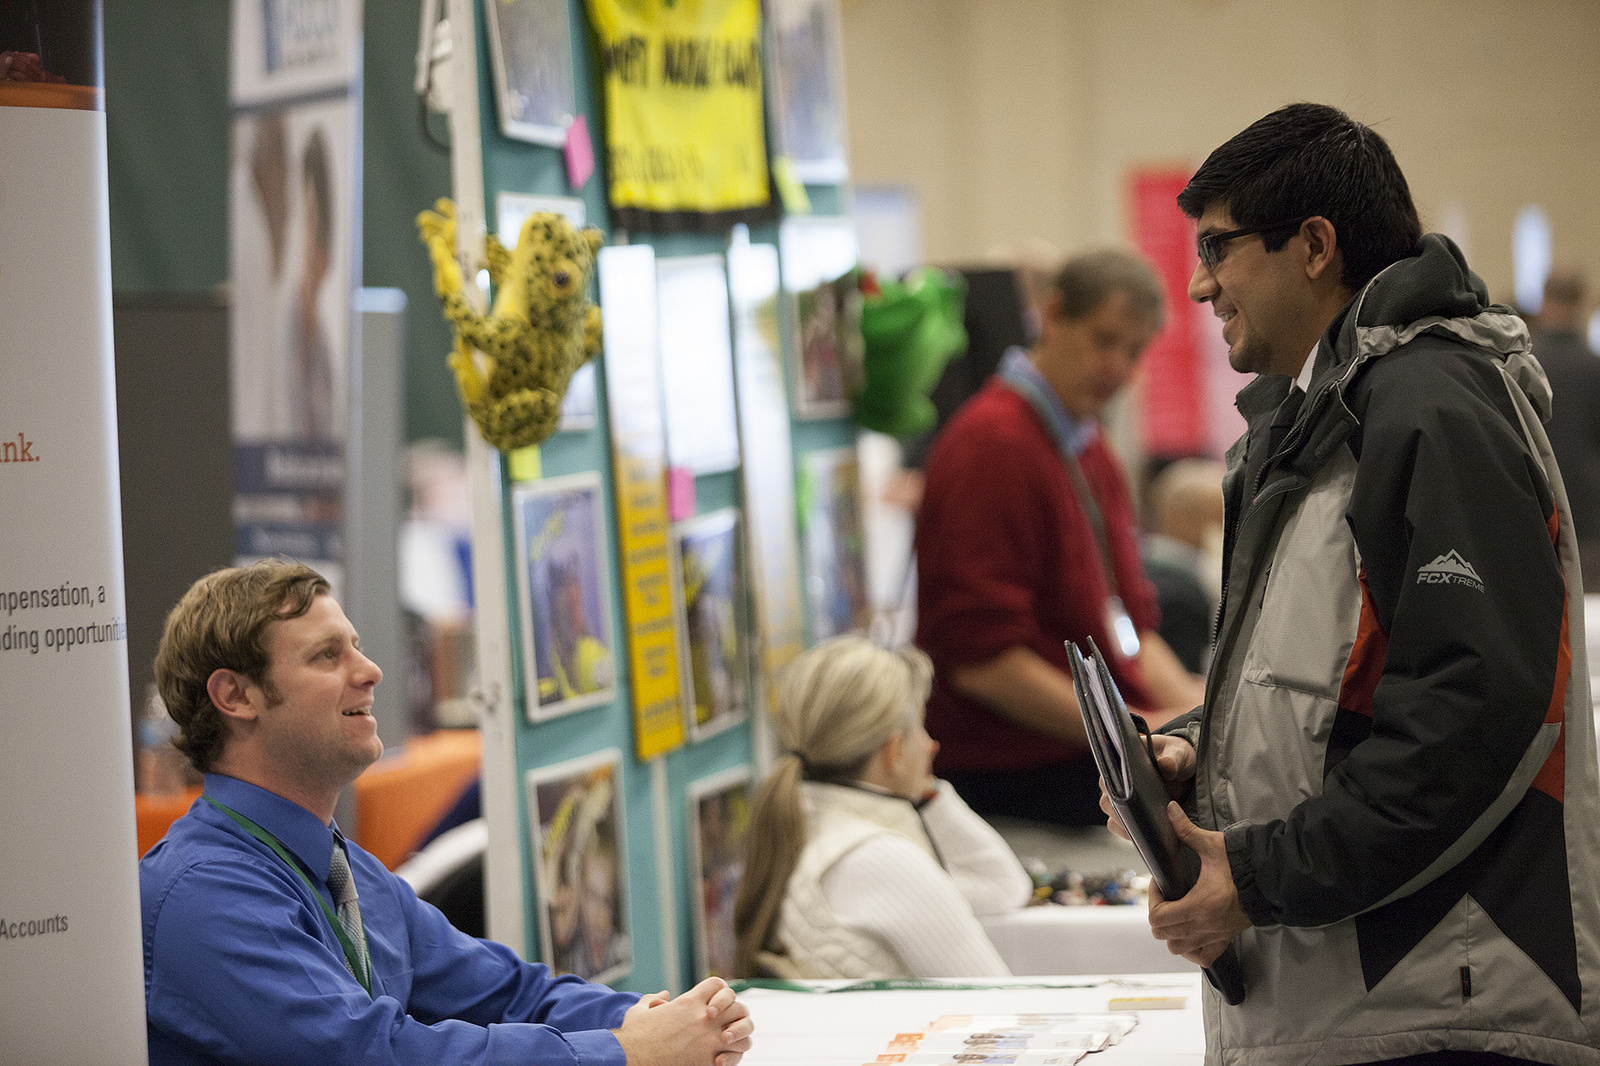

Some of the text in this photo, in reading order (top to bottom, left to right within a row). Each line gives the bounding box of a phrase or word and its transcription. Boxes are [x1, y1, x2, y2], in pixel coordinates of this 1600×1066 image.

[0, 432, 41, 463] nk.
[98, 585, 106, 603] a
[0, 625, 39, 655] ding
[0, 914, 69, 939] Accounts
